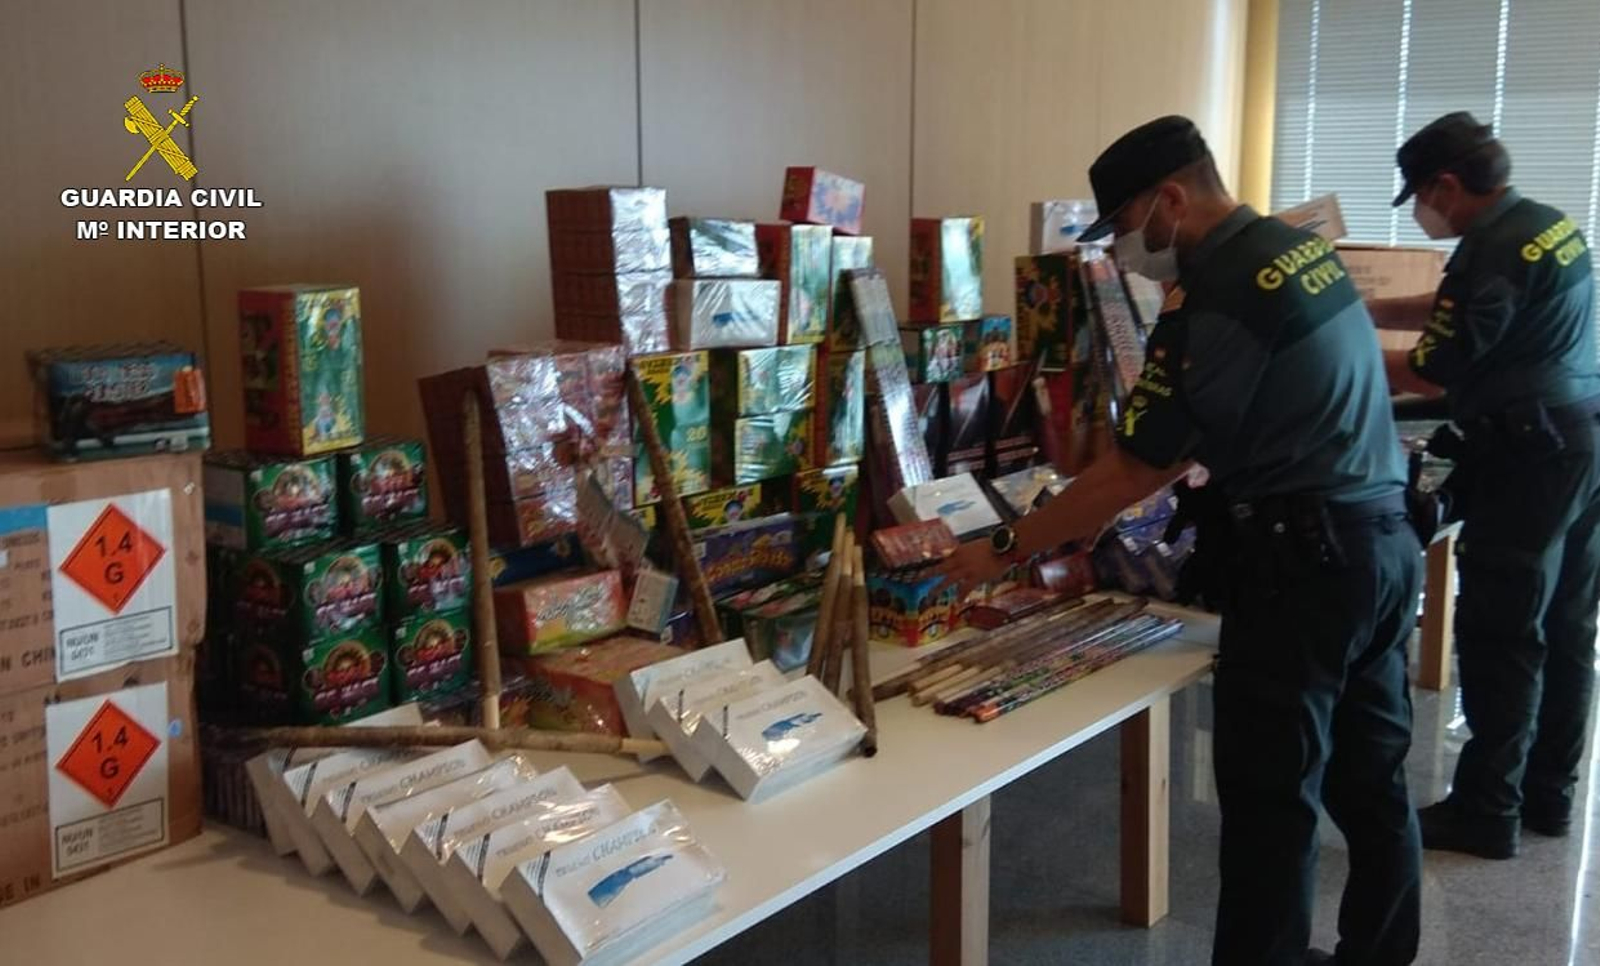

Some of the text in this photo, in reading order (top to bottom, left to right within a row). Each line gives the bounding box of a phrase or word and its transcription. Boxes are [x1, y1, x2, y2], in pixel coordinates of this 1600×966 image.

[94, 531, 133, 558] 1.4
[103, 561, 125, 585] G
[92, 725, 129, 754] 1.4
[100, 756, 120, 780] G
